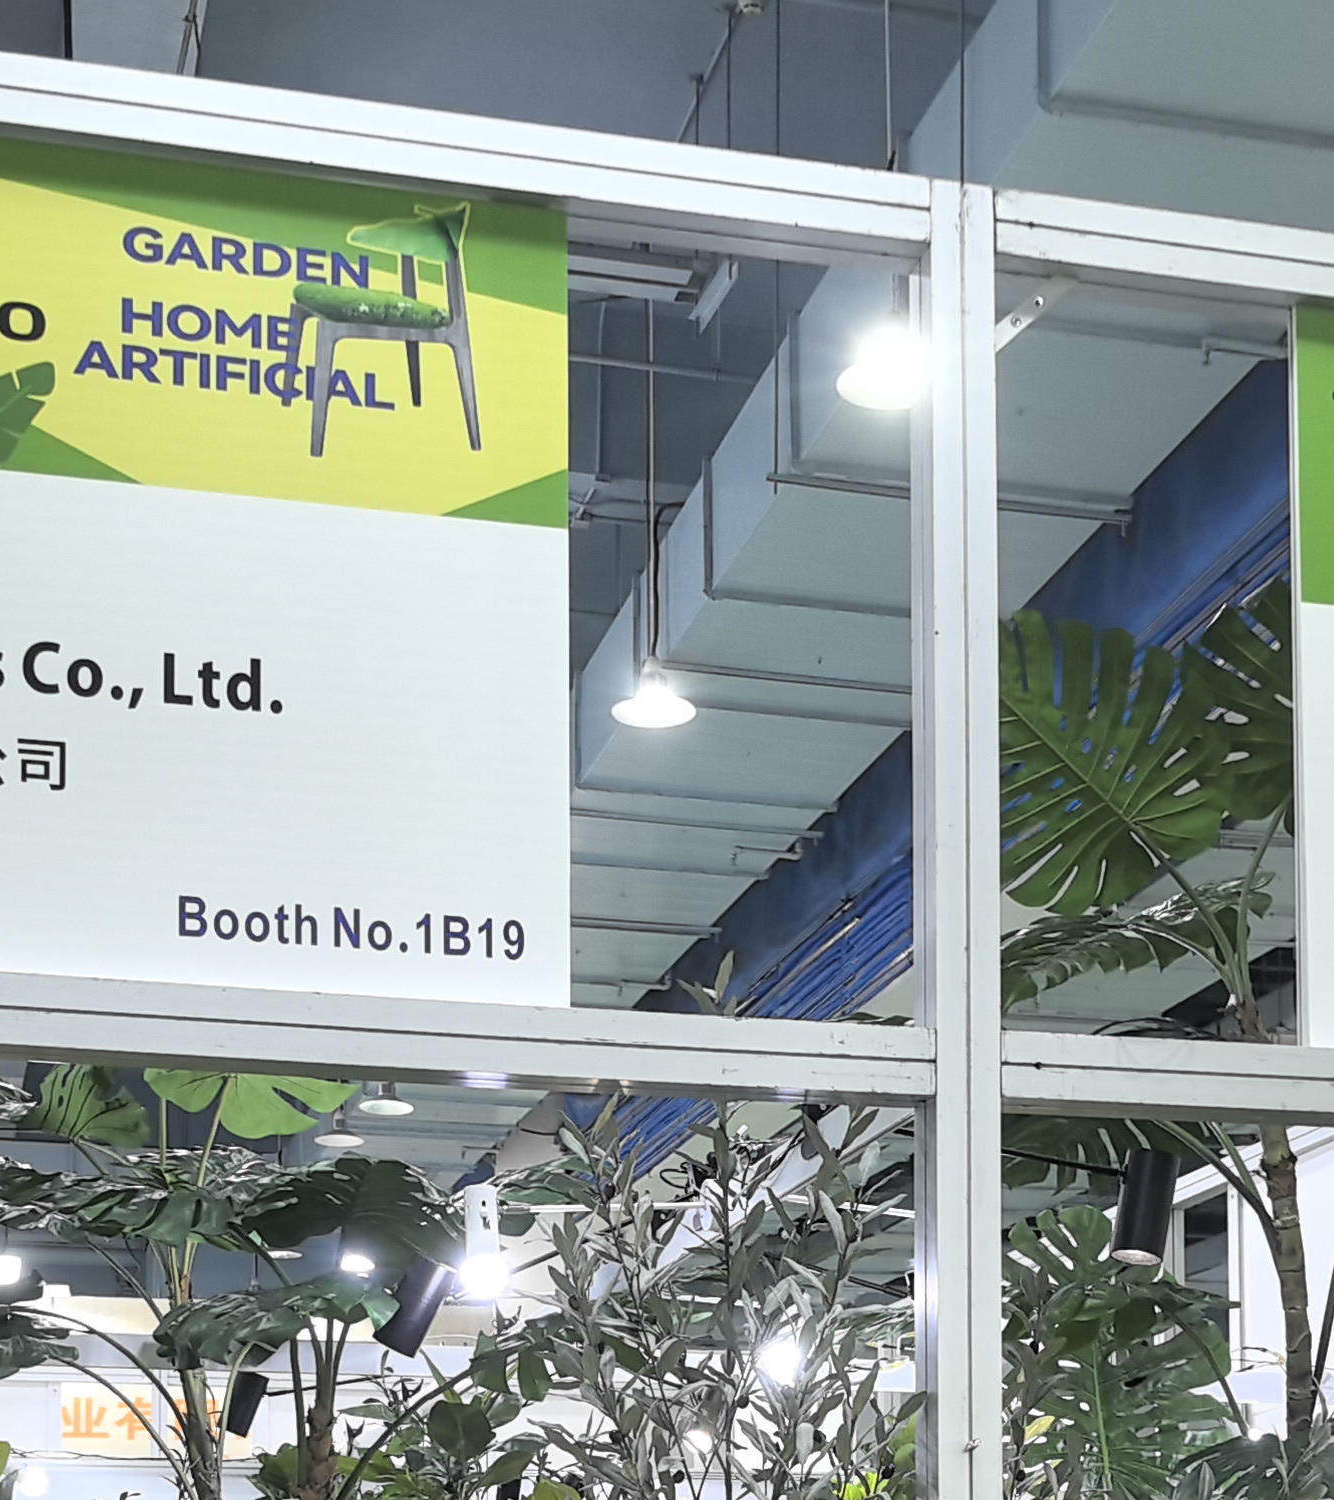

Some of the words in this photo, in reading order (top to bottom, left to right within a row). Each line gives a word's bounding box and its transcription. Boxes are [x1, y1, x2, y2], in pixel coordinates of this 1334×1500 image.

[122, 226, 370, 290] GARDEN
[120, 296, 299, 353] HOME
[72, 340, 396, 411] ARTIFICIAL
[22, 641, 145, 709] Co.,
[163, 652, 284, 714] Ltd.
[177, 895, 318, 946] Booth
[333, 906, 526, 961] No.1B19
